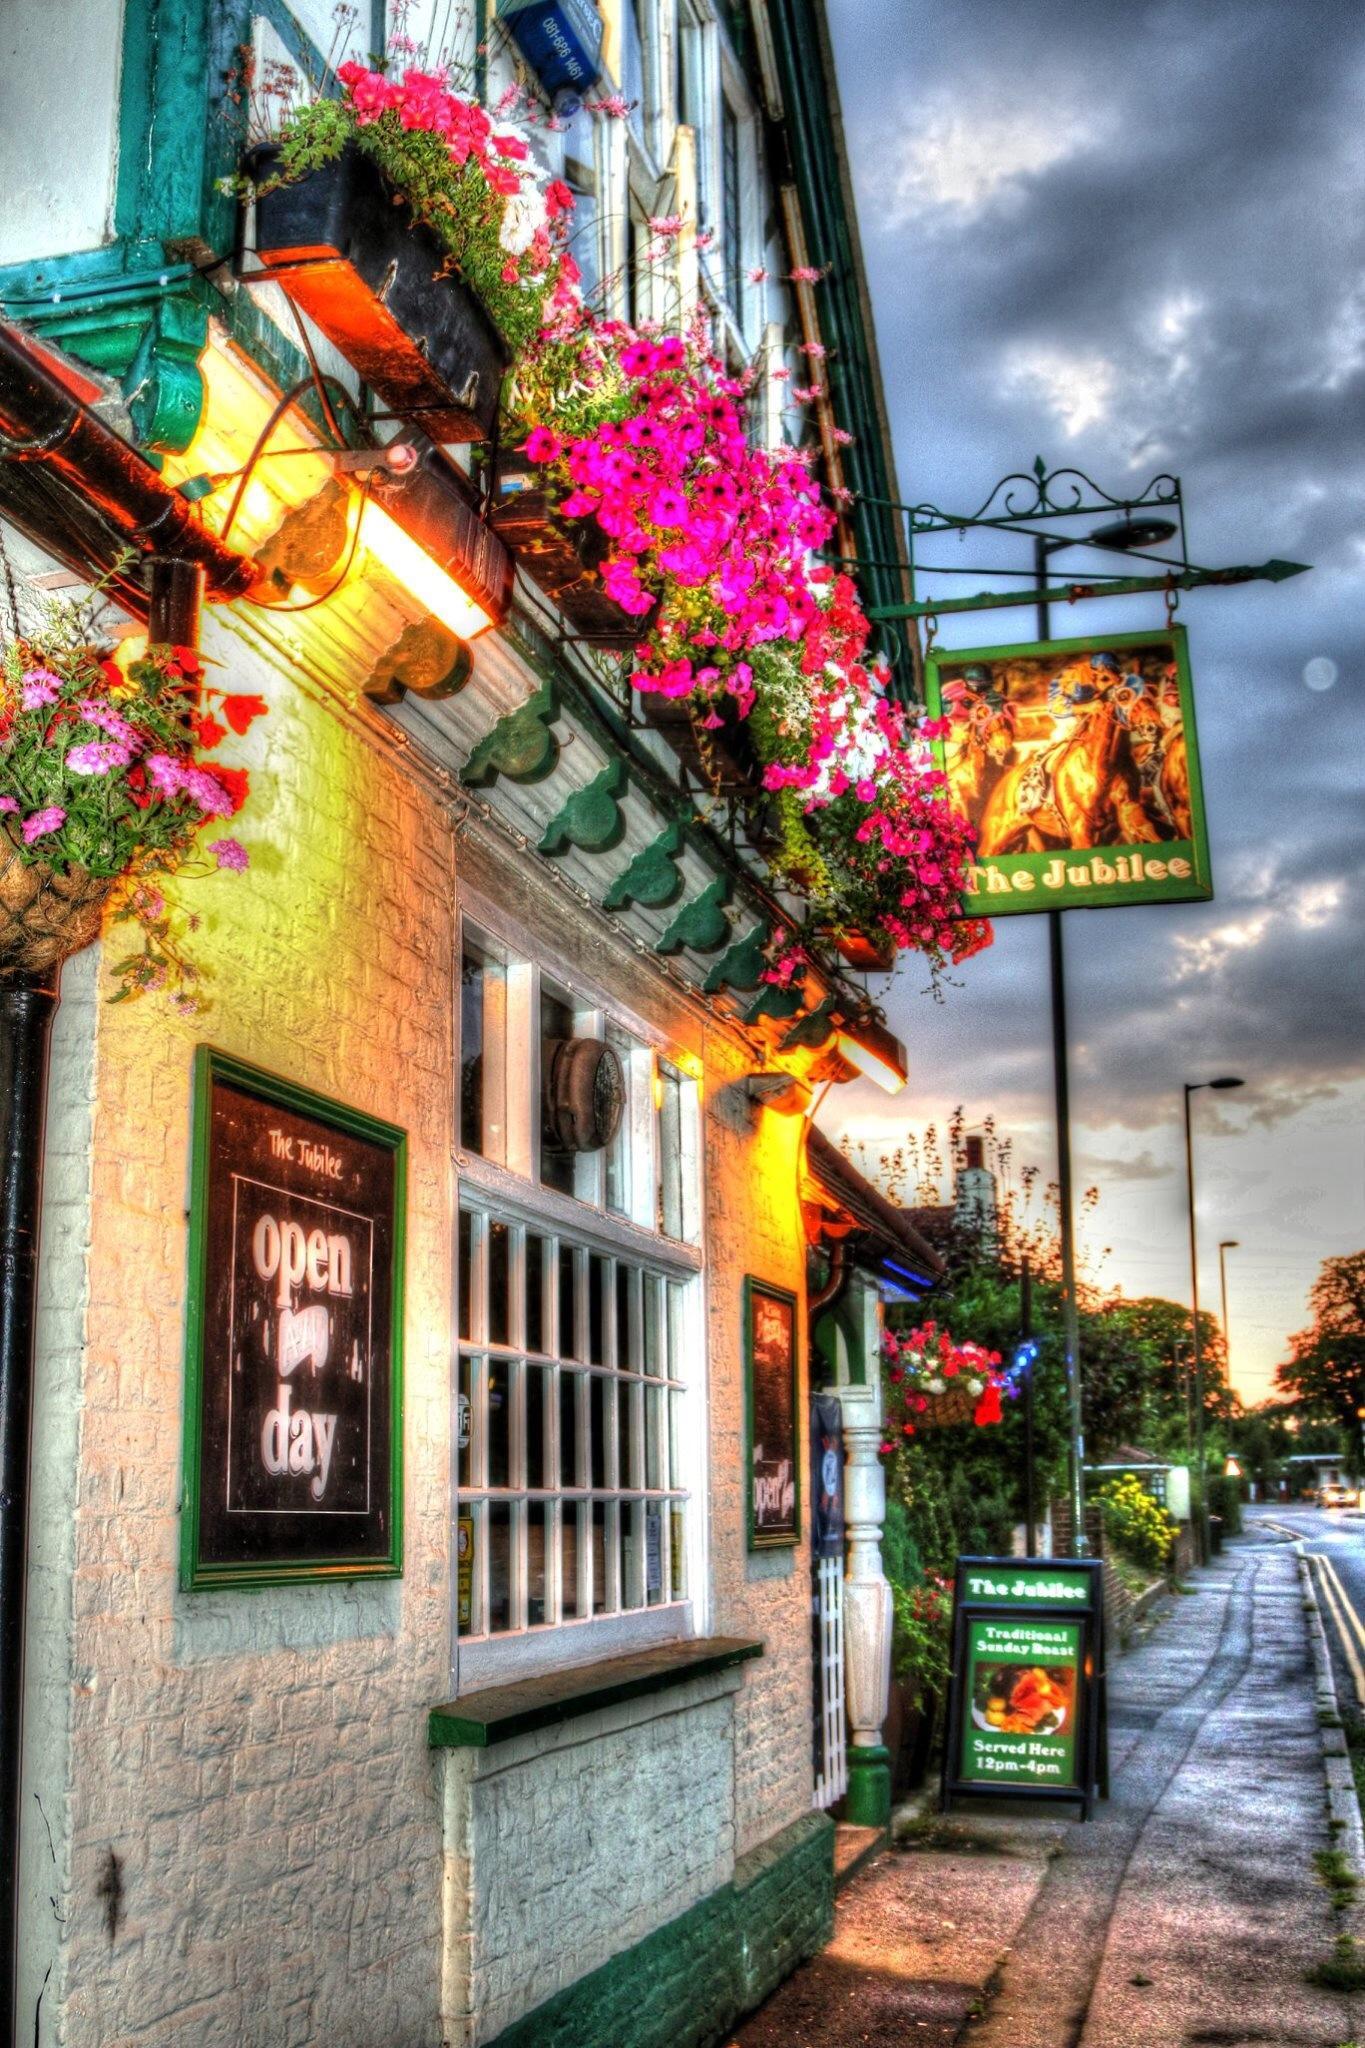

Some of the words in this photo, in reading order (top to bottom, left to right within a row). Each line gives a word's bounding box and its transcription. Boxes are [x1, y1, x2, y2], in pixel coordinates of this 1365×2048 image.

[565, 56, 584, 80] 1461
[964, 865, 1035, 895] The
[1042, 853, 1192, 889] Jubilee
[268, 1129, 294, 1161] The
[297, 1139, 343, 1180] Jubilee
[253, 1213, 353, 1309] open
[260, 1385, 338, 1501] day
[968, 1578, 1009, 1596] The
[1011, 1580, 1087, 1599] Jubilee
[985, 1627, 1068, 1642] Traditional
[977, 1640, 1030, 1656] Sunday
[1031, 1642, 1075, 1656] Roast
[973, 1739, 1026, 1755] Served
[1029, 1743, 1066, 1757] Here
[976, 1756, 1061, 1775] 12pm-4pm
